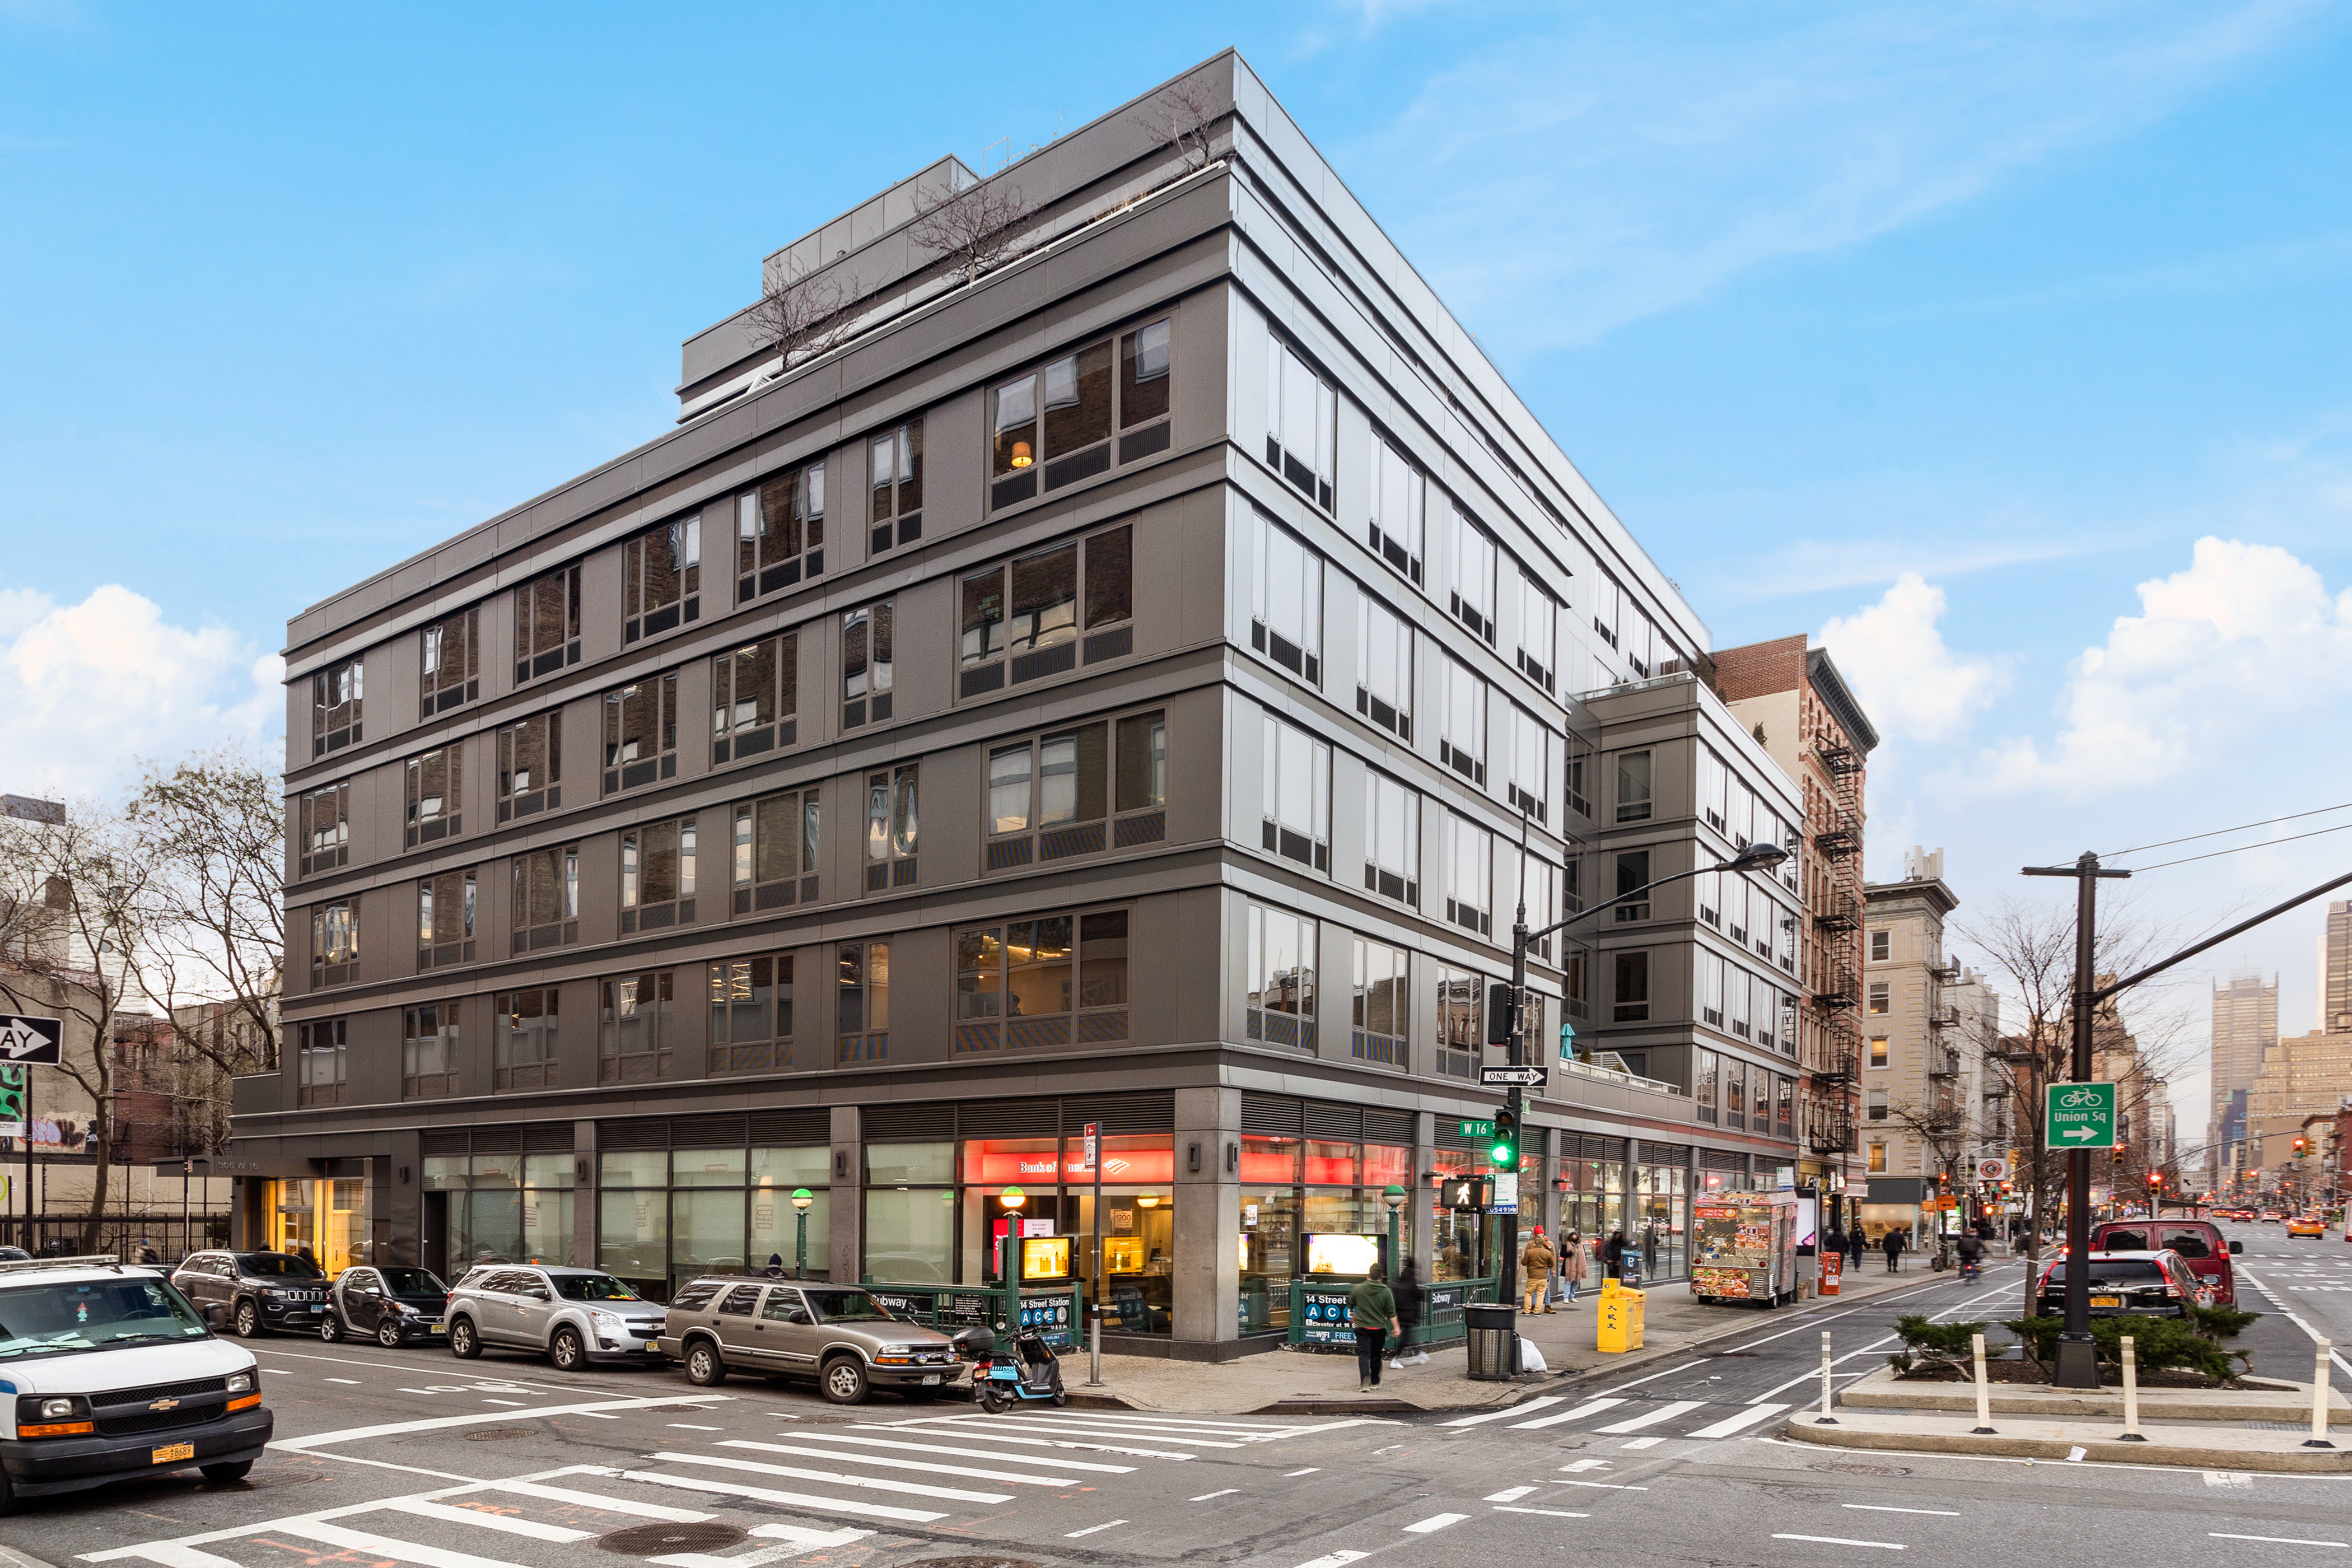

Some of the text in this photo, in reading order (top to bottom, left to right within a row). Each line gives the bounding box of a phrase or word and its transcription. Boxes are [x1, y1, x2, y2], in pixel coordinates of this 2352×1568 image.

[0, 1029, 34, 1048] AY
[1489, 1072, 1509, 1081] ONE
[2054, 1110, 2107, 1124] Union Sq
[1464, 1123, 1472, 1135] W
[1476, 1123, 1487, 1135] 16
[218, 1161, 235, 1170] 305
[1020, 1161, 1045, 1173] Bank
[1045, 1161, 1057, 1173] of
[1020, 1298, 1070, 1309] 14 Street Station
[1318, 1295, 1347, 1305] Street
[1022, 1313, 1029, 1323] A
[1034, 1312, 1041, 1322] C
[1059, 1310, 1064, 1319] L
[1309, 1306, 1318, 1317] A
[1327, 1307, 1337, 1318] C
[175, 1446, 191, 1457] 8689
